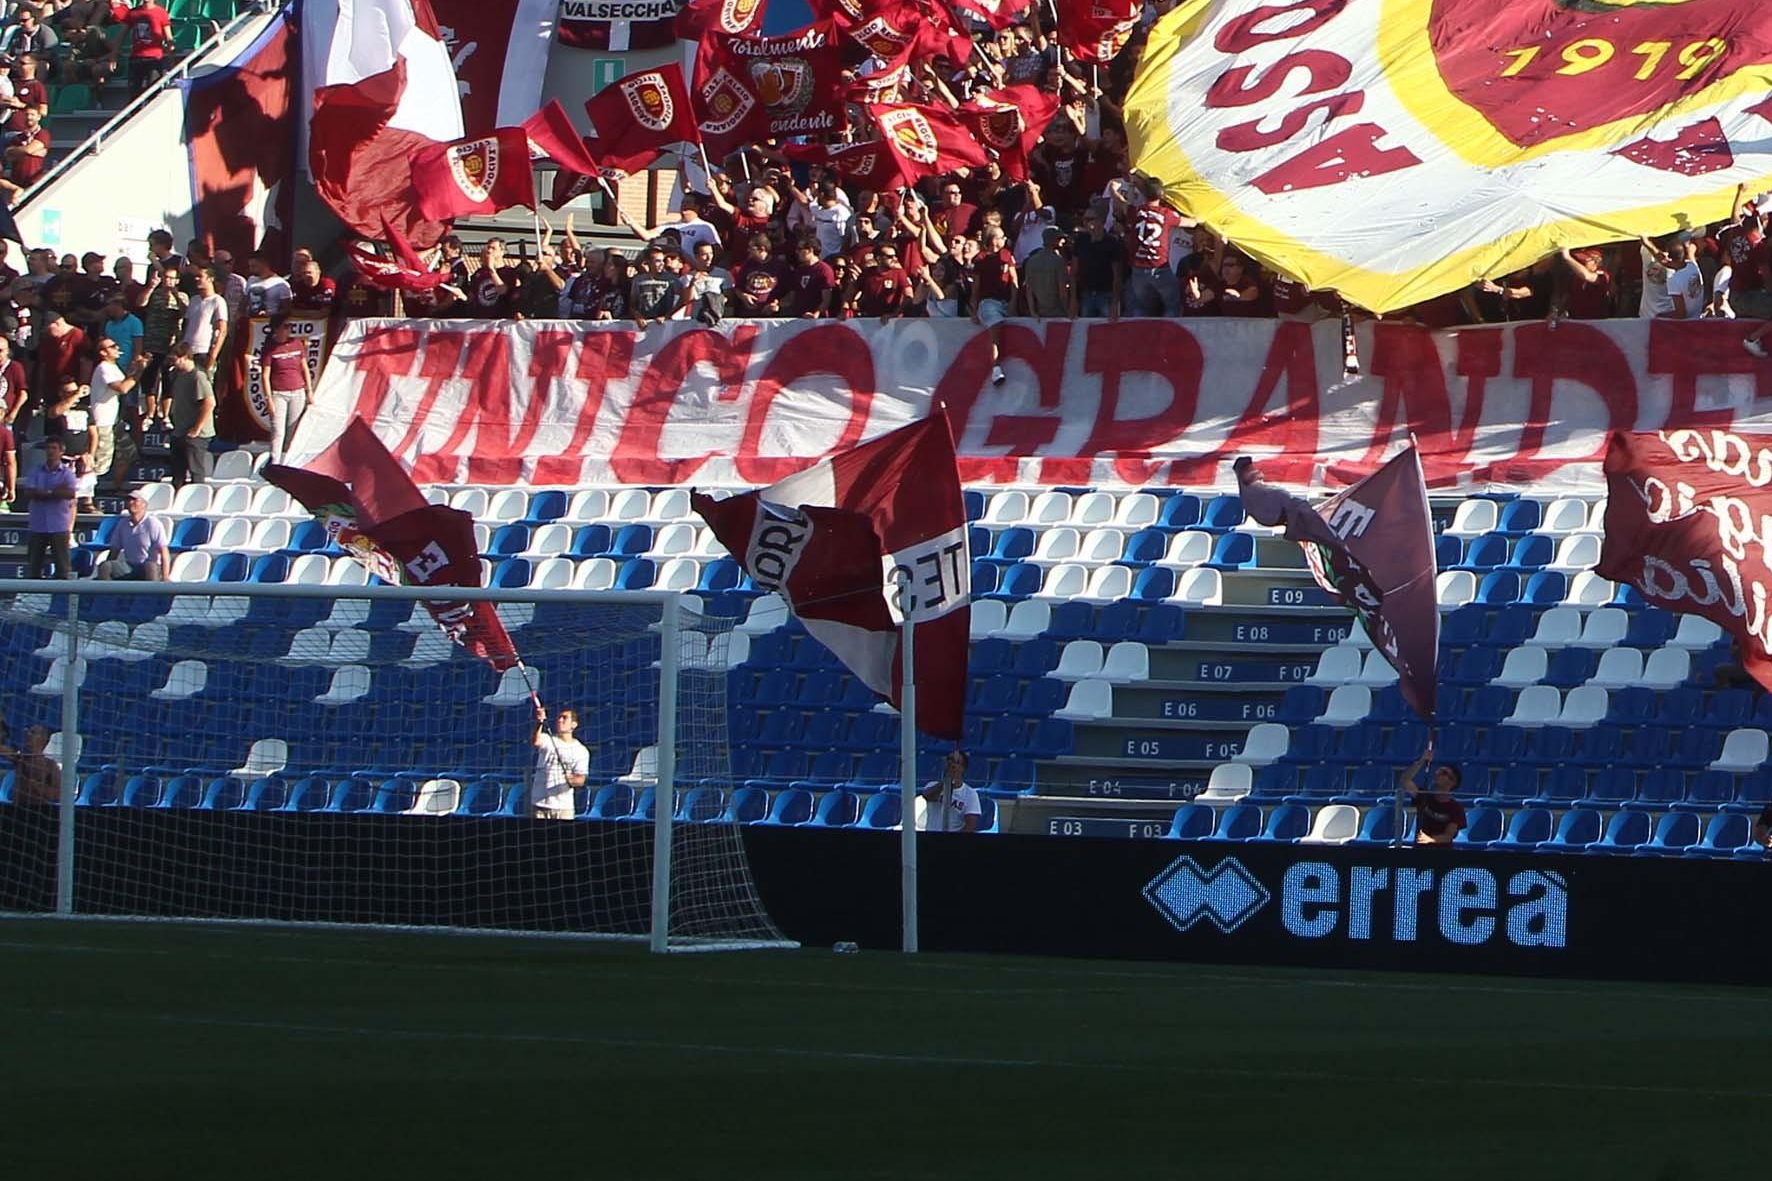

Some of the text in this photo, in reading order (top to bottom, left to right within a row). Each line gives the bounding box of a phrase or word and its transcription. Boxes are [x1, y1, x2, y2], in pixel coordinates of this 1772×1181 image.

[1503, 35, 1727, 83] 1919
[350, 323, 876, 487] UNICO
[1272, 591, 1303, 603] E 09
[1237, 627, 1268, 639] E 08
[1314, 629, 1346, 641] F 08
[1201, 666, 1232, 678] E 07
[1279, 667, 1311, 679] F 07
[1165, 703, 1197, 716] E 06
[1243, 705, 1275, 717] F 06
[1127, 742, 1159, 755] E 05
[1206, 744, 1238, 757] F 05
[1050, 822, 1082, 835] E 03
[1129, 824, 1162, 838] F 03
